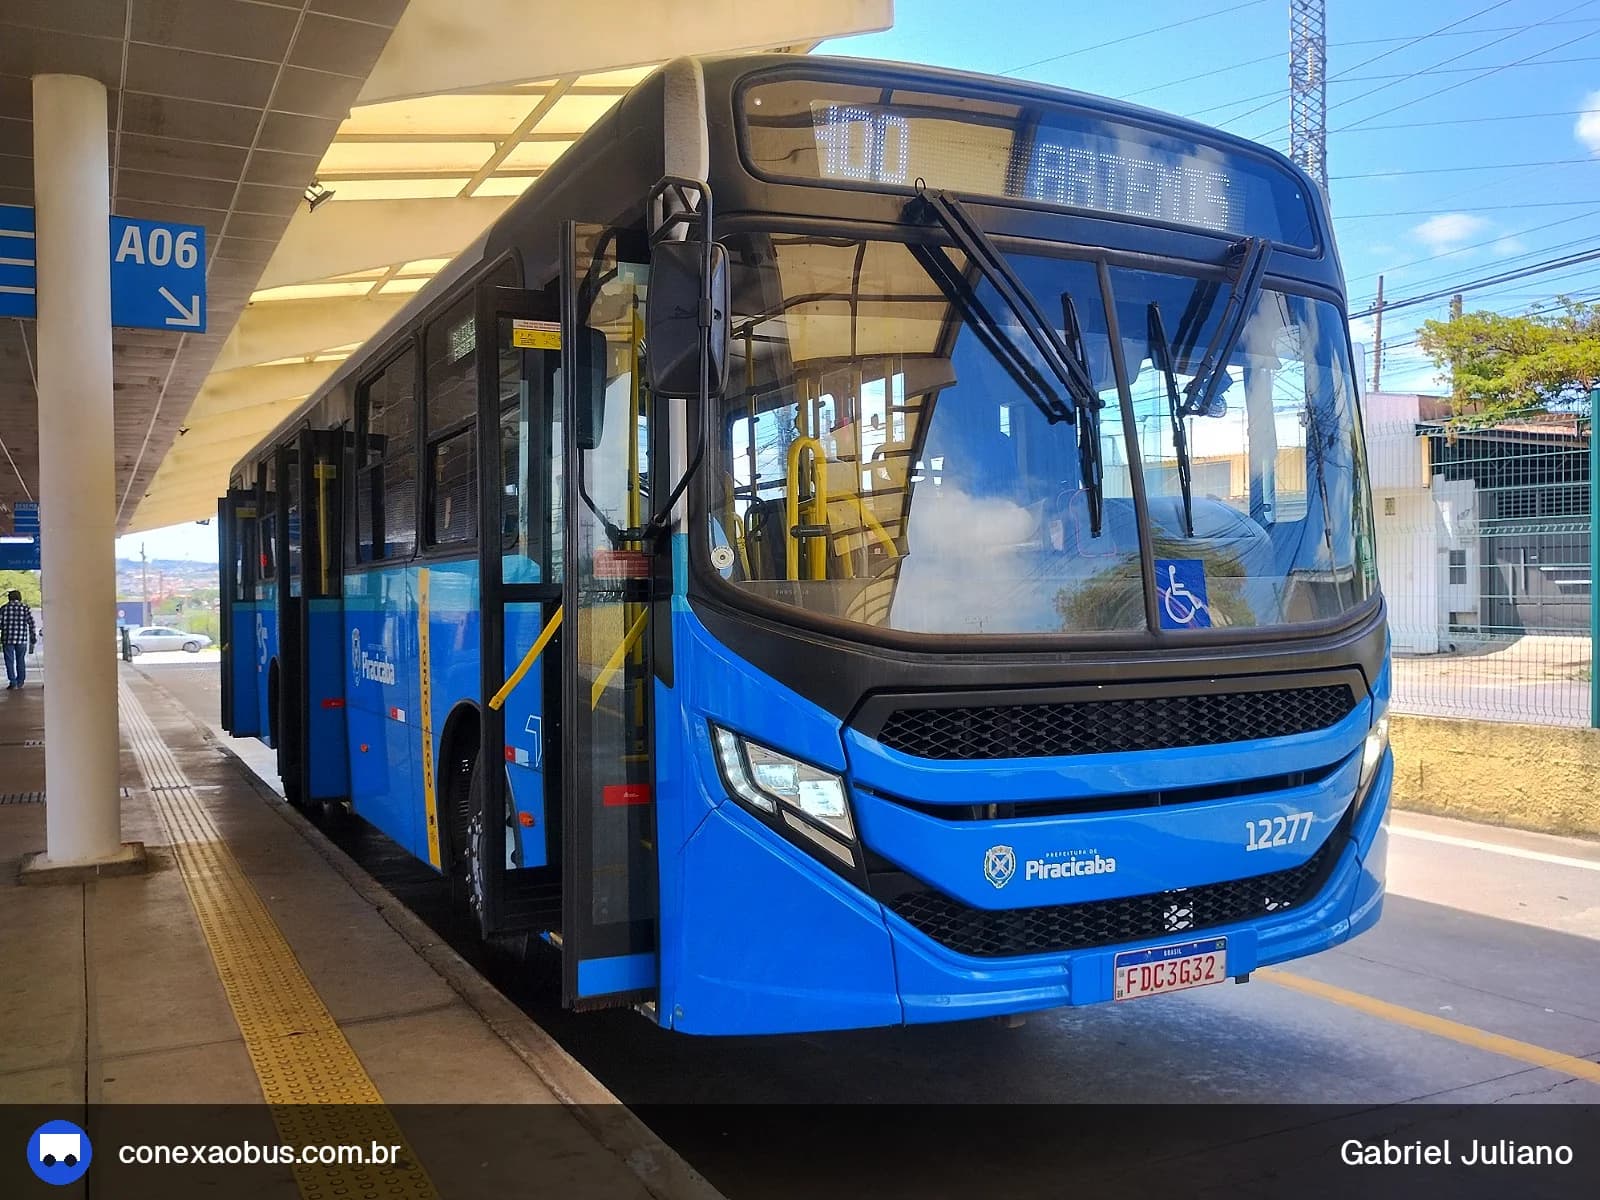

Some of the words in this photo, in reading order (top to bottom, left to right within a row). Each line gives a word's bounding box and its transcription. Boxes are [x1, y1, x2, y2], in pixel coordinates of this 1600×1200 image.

[816, 105, 908, 184] 100
[1035, 143, 1231, 231] ARTEMIS
[115, 225, 198, 269] A06
[1245, 811, 1313, 852] 12277
[1025, 854, 1116, 881] Piracicaba
[1045, 849, 1087, 858] PREFEITURA
[1163, 948, 1182, 957] BRASIL
[1126, 955, 1215, 994] FDC3G32
